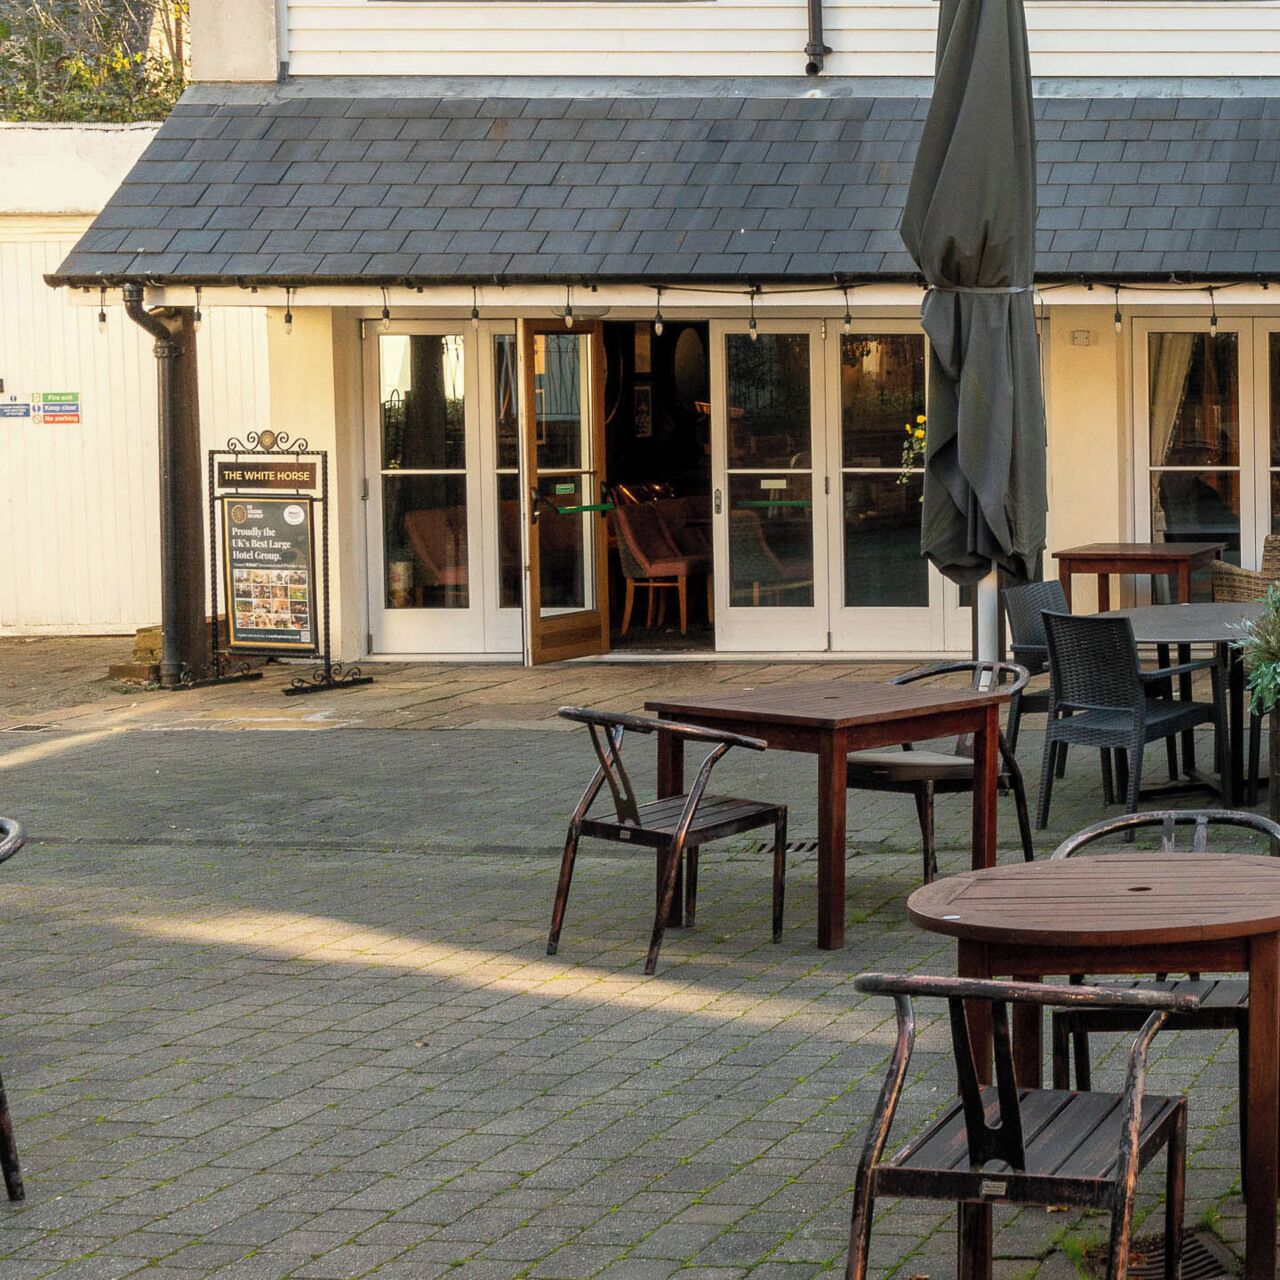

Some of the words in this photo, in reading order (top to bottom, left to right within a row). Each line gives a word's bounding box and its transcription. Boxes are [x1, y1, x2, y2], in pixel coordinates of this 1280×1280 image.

[223, 470, 243, 480] THE
[244, 471, 275, 481] WHITE
[277, 471, 310, 481] HORSE
[232, 527, 262, 538] Proudly
[263, 527, 277, 537] the
[251, 539, 268, 548] Best
[269, 540, 292, 550] Large
[233, 550, 254, 560] Hotel
[255, 551, 282, 561] Group.
